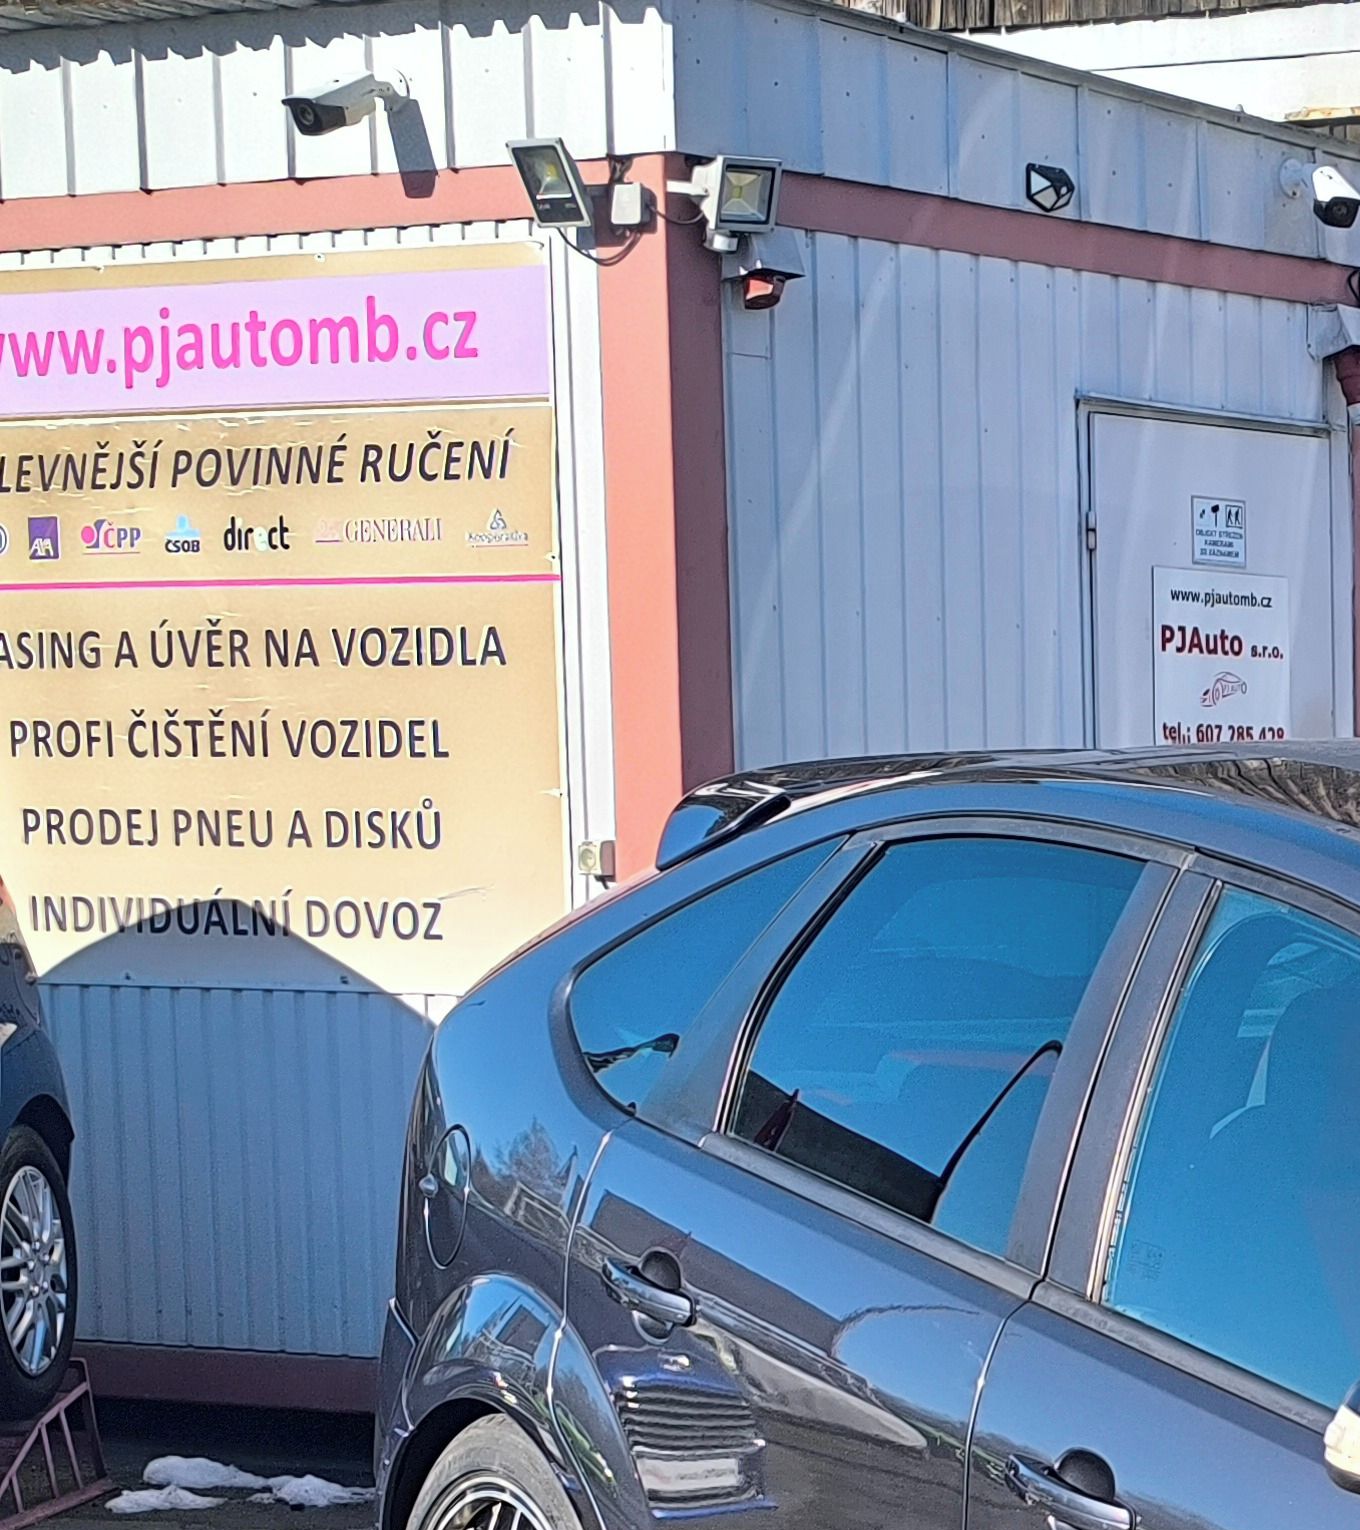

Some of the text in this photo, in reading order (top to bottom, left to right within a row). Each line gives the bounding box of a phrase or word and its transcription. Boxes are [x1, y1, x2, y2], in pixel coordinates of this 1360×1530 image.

[0, 296, 479, 389] ww.pjautomb.cz
[171, 433, 348, 489] POVINNÉ
[359, 427, 515, 484] RUČENÍ
[103, 521, 142, 549] ČPP
[165, 537, 201, 553] ČSOB
[223, 514, 290, 551] direct
[345, 517, 443, 543] GENERALI
[1170, 588, 1273, 608] www.pjautomb.cz
[114, 630, 138, 668] A
[149, 619, 251, 668] ÚVĚR
[264, 628, 320, 668] NA
[332, 625, 507, 667] VOZIDLA
[1160, 624, 1284, 659] PJAuto s.r.o.
[10, 708, 450, 759] PROFI ČIŠTĚNÍ VOZIDEL
[1196, 723, 1222, 743] 607
[22, 797, 442, 850] PRODEJ PNEU A DISKŮ
[30, 888, 443, 941] INDIVIDUÁLNÍ DOVOZ
